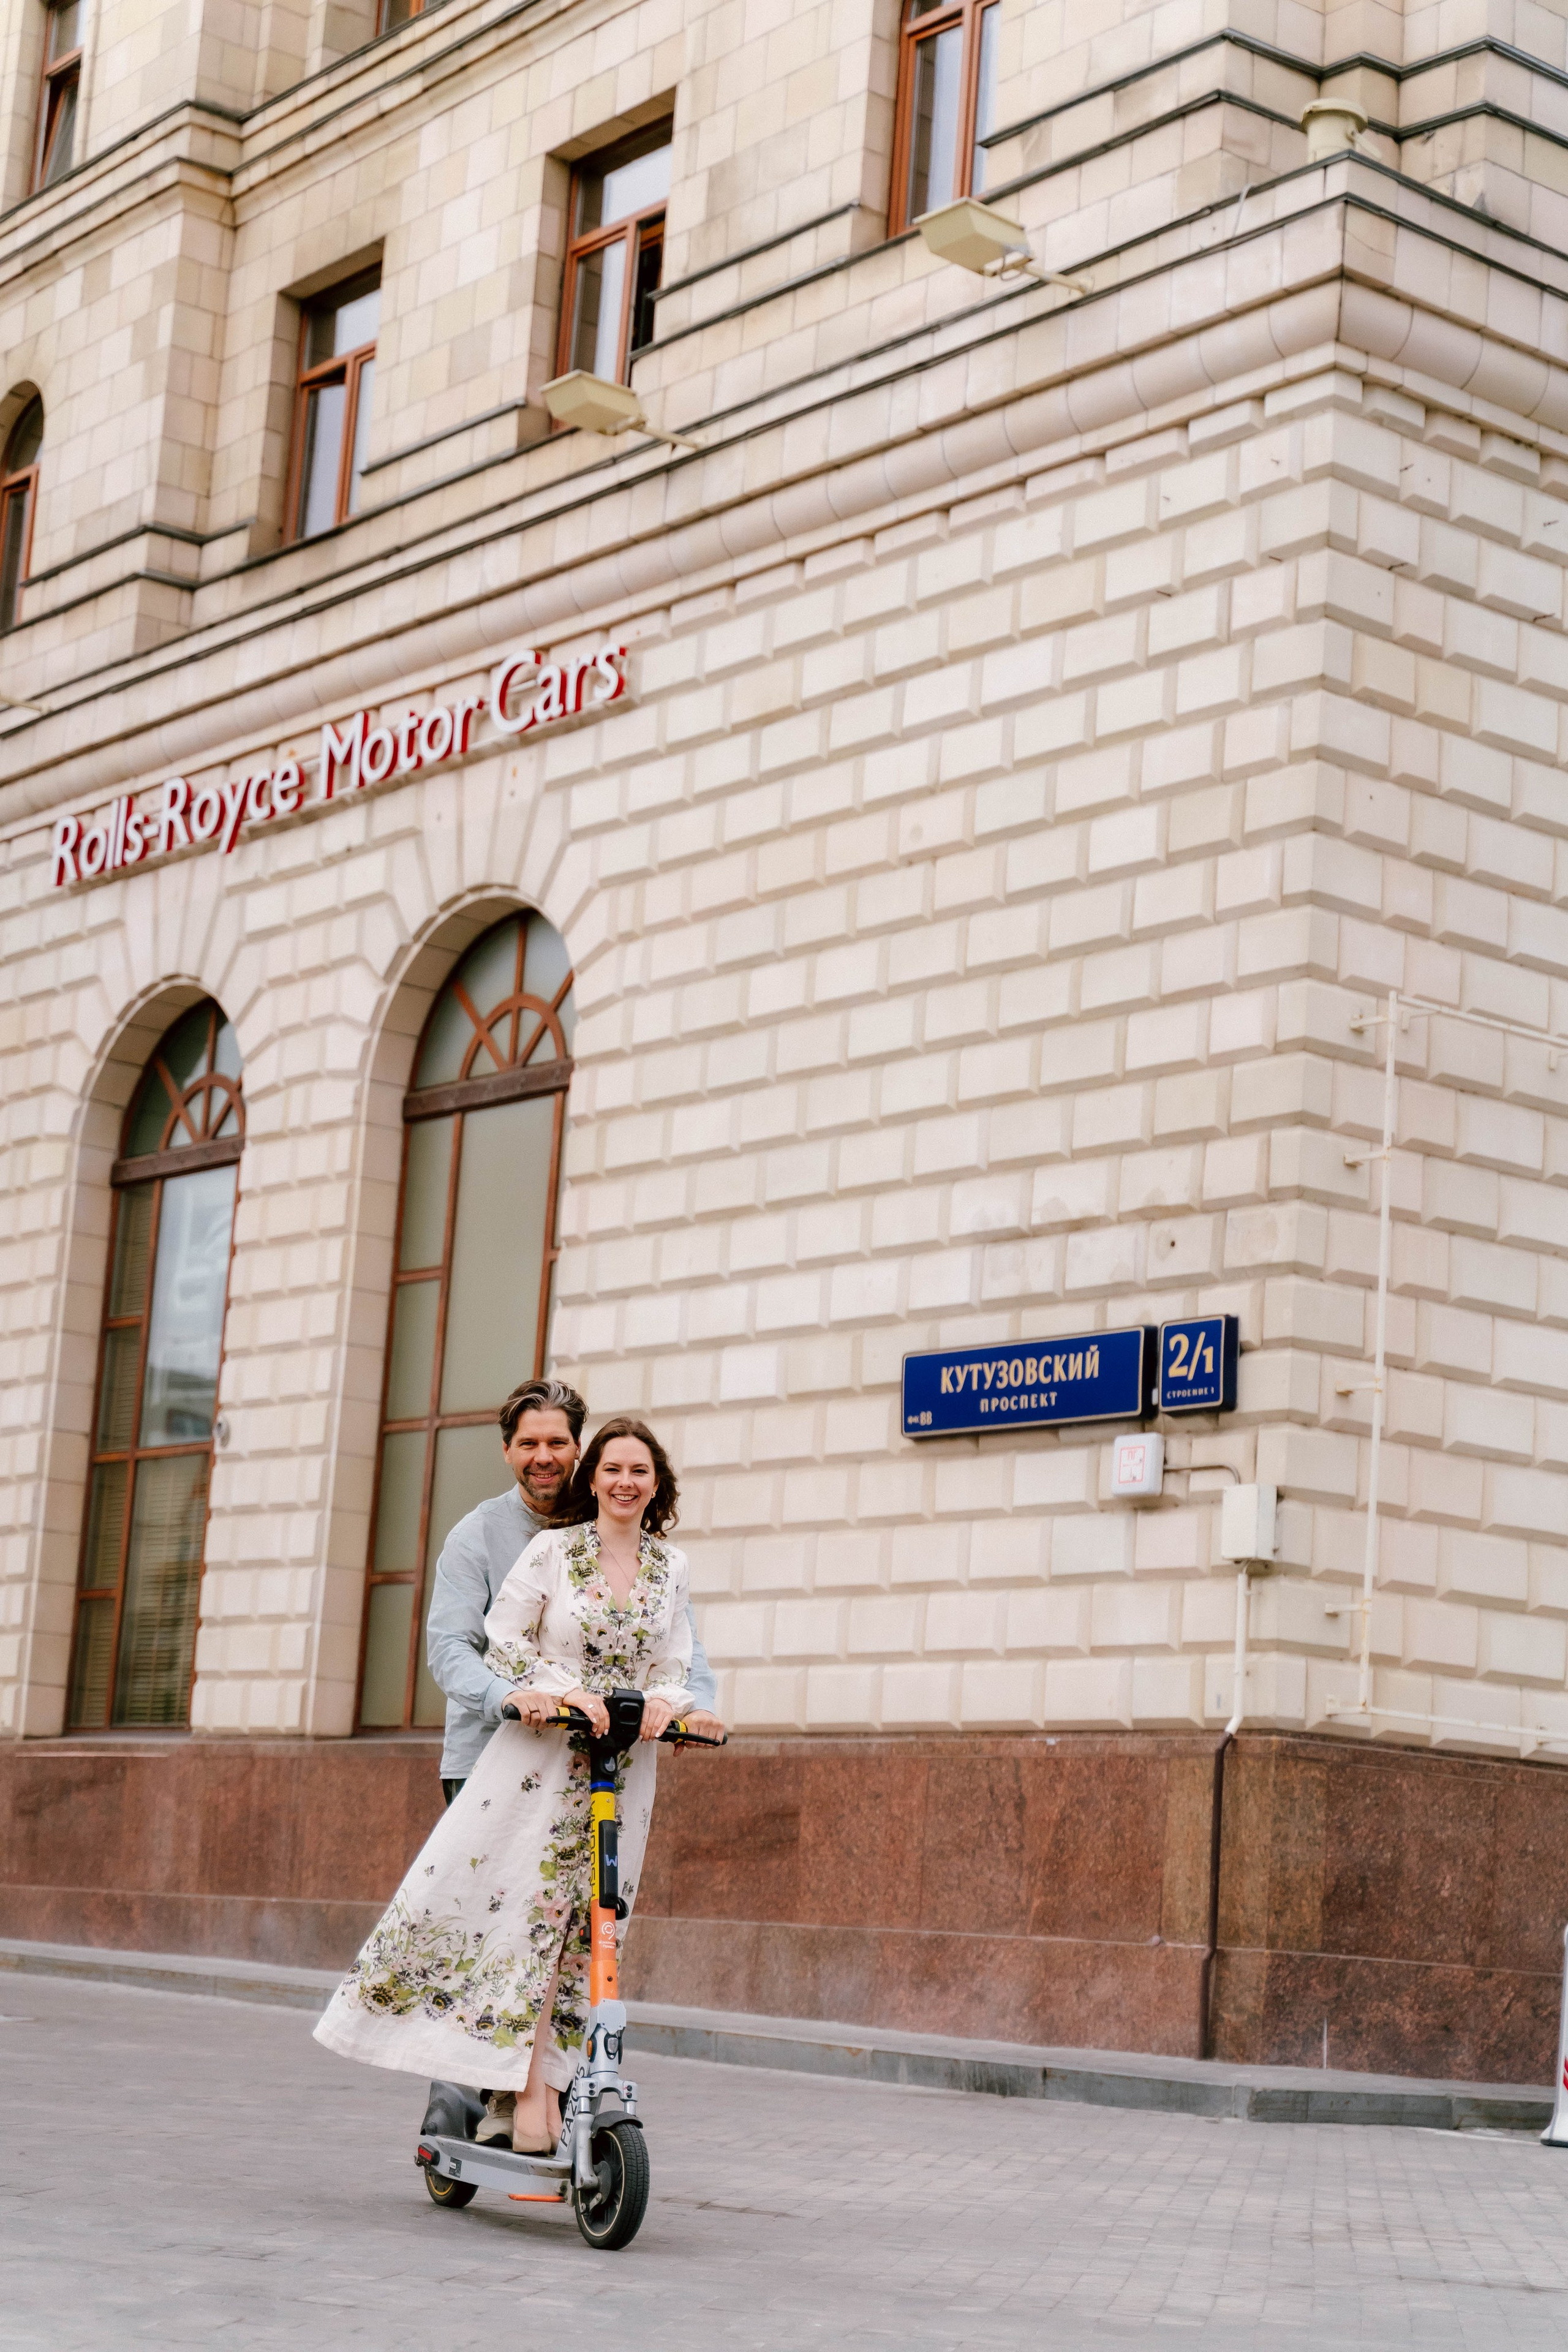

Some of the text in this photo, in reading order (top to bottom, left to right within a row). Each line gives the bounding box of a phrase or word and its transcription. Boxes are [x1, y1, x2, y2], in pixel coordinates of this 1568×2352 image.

[51, 643, 627, 886] Rolls-Royce Motor Cars
[940, 1344, 1100, 1394] КУТУЗОВСКИЙ
[1168, 1331, 1214, 1381] 2/1
[980, 1391, 1058, 1413] ПРОСПЕКТ
[1166, 1387, 1209, 1400] СТРОЕНИЕ
